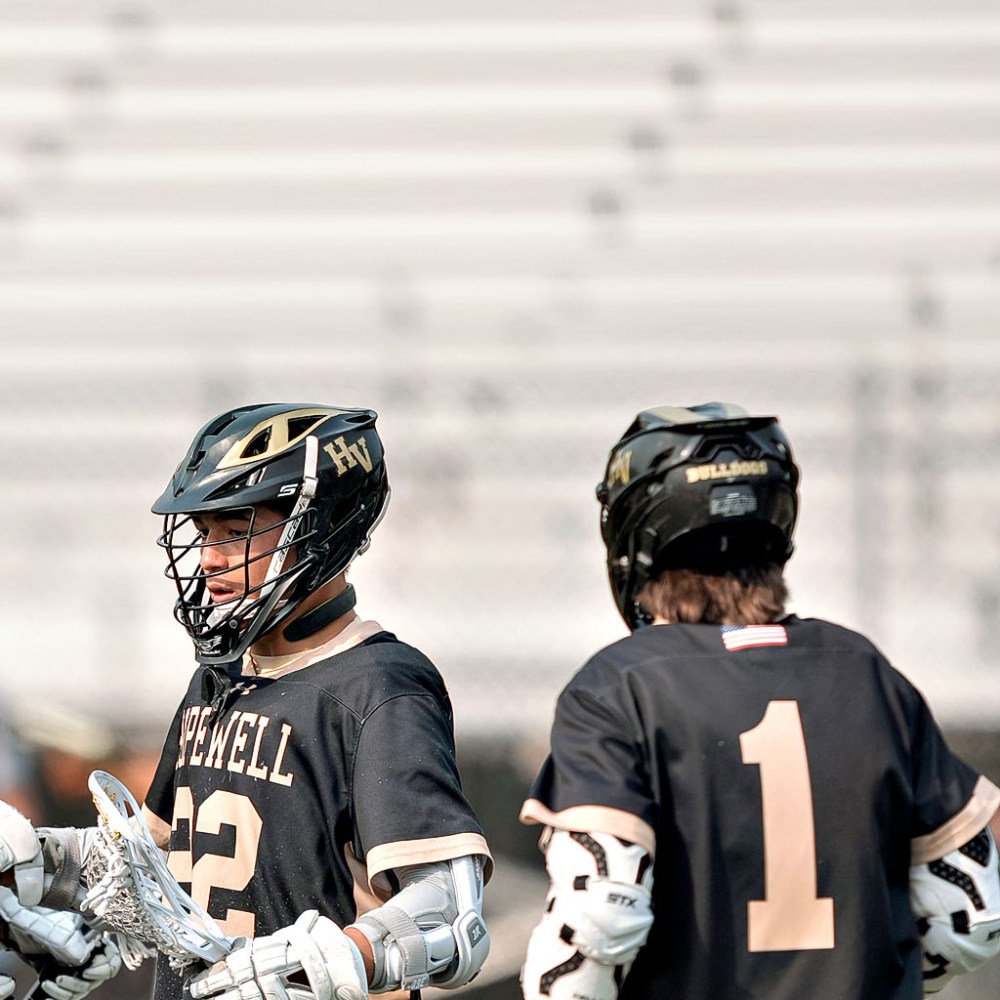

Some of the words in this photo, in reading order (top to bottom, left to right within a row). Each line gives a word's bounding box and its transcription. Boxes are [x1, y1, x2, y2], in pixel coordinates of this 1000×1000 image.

[323, 436, 373, 477] HV
[685, 460, 768, 484] BULLDOGS
[739, 700, 835, 952] 1
[606, 892, 637, 908] STX
